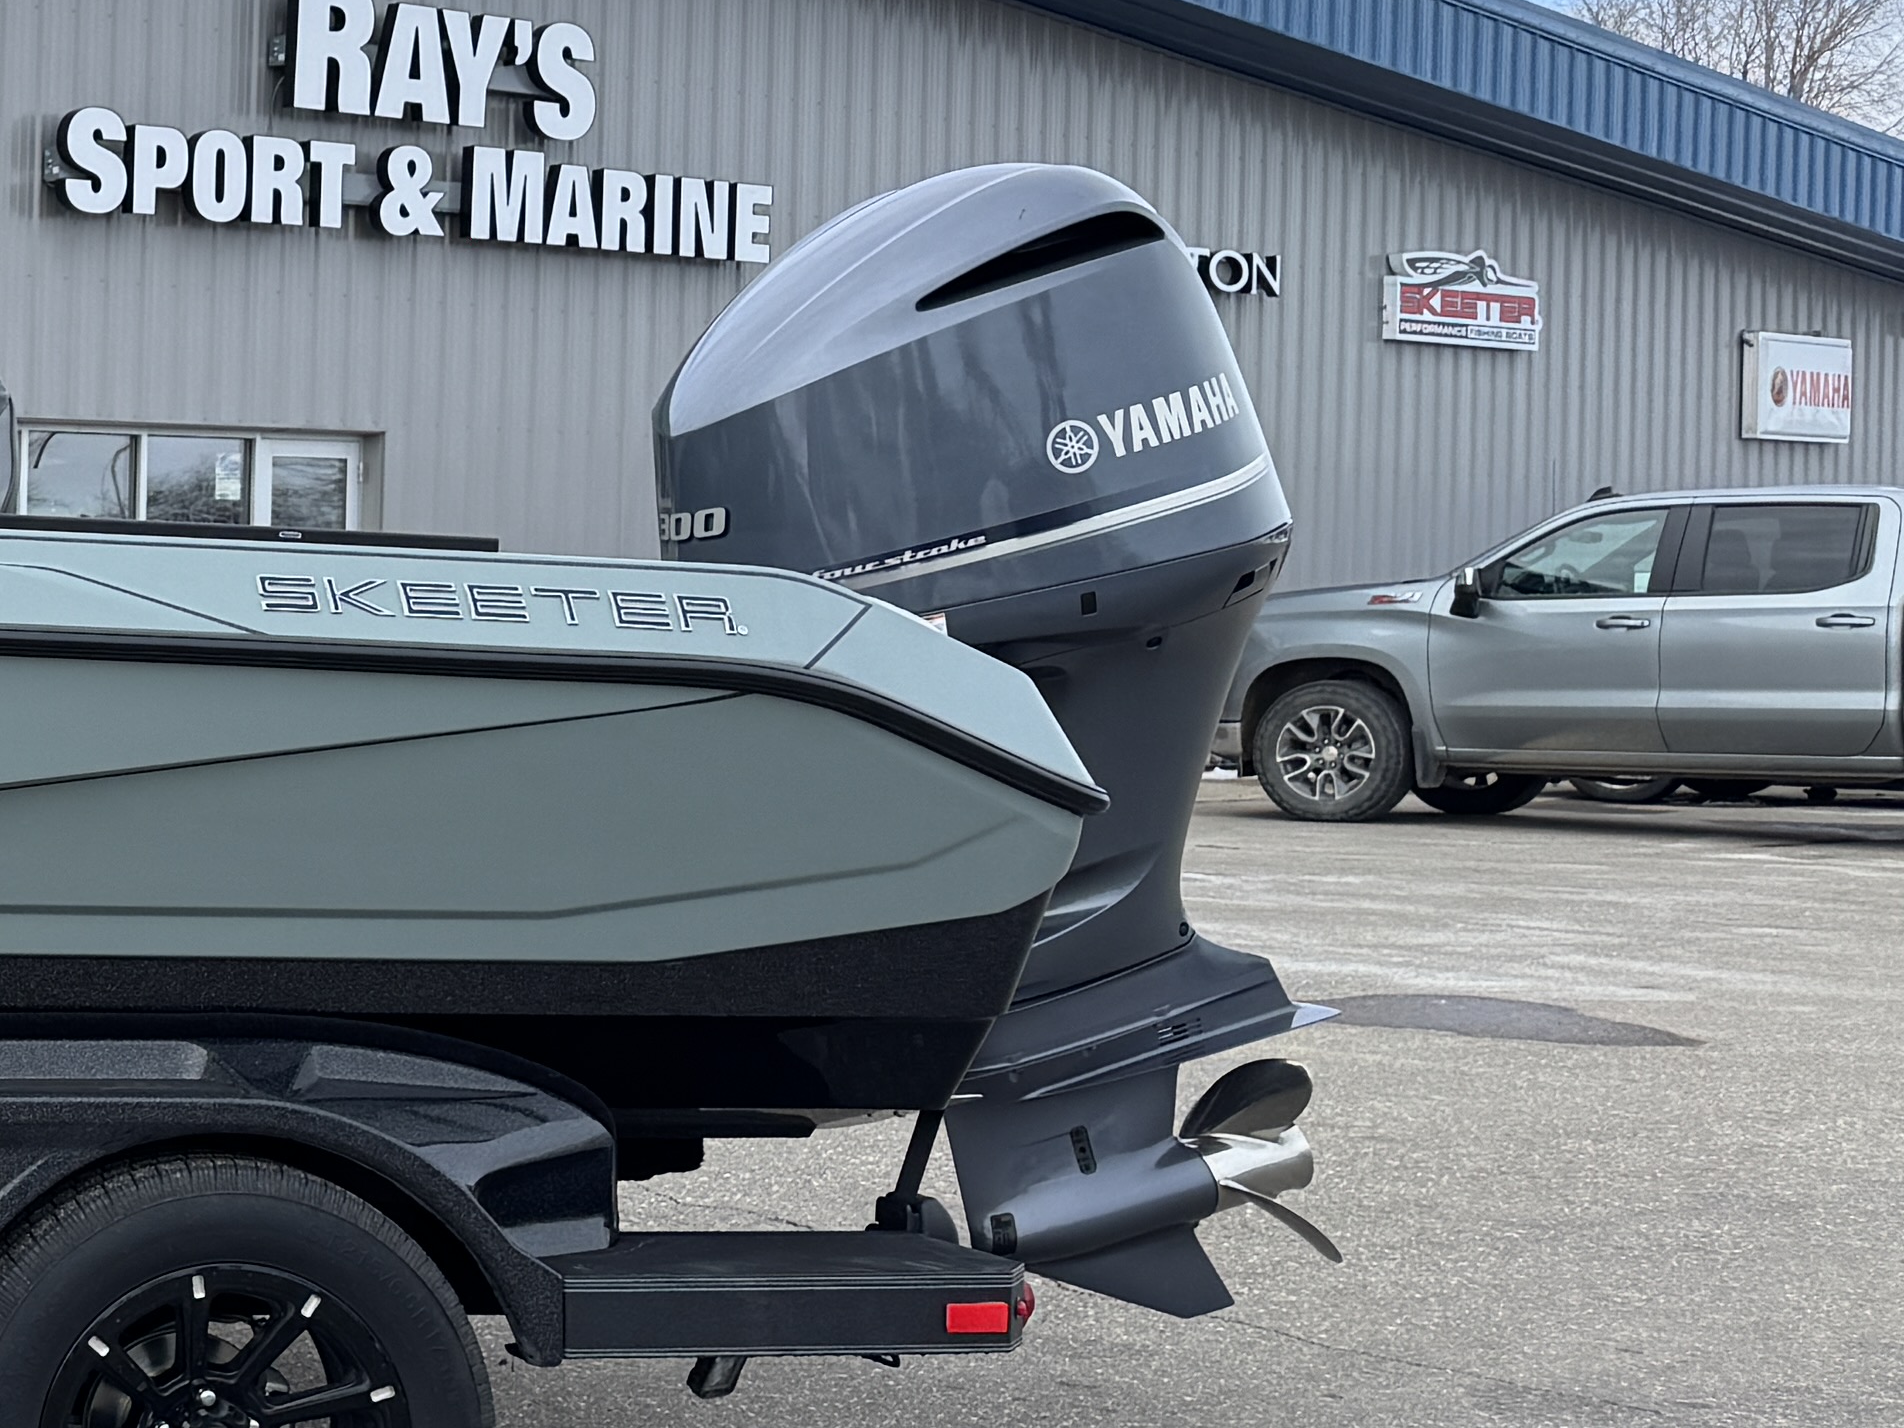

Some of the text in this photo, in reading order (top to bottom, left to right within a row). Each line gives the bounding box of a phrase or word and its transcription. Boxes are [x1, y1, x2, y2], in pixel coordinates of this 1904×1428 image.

[60, 107, 774, 264] SPORT & MARINE
[1399, 283, 1537, 326] SKEETER
[1399, 321, 1467, 338] PERFORMANCE
[1790, 369, 1850, 409] YAMAHA
[1096, 373, 1240, 458] YAMAHA
[256, 574, 738, 635] SKEETER
